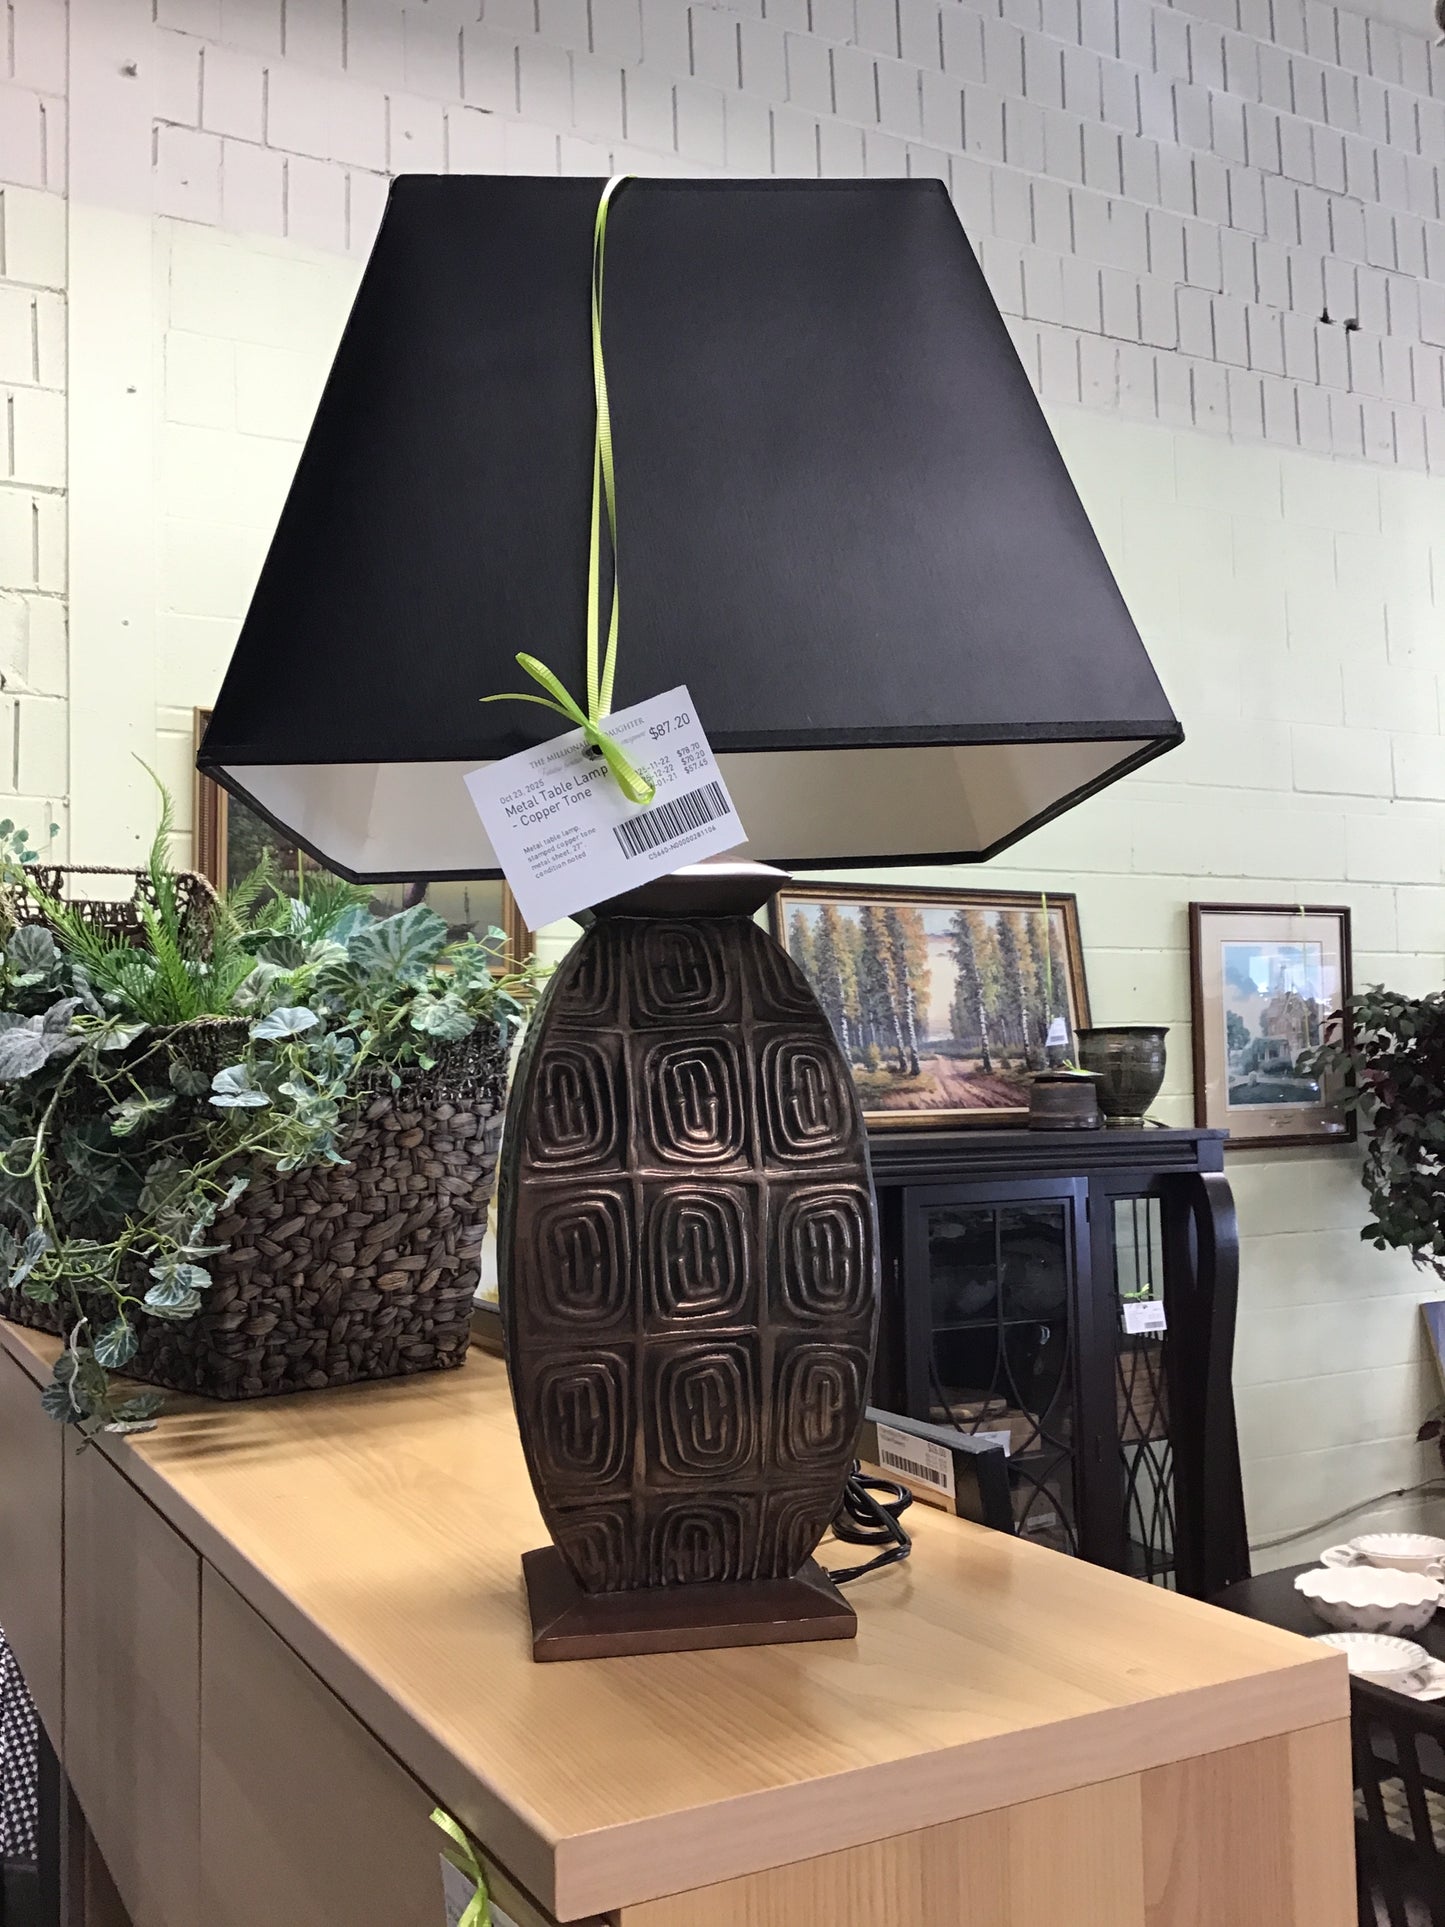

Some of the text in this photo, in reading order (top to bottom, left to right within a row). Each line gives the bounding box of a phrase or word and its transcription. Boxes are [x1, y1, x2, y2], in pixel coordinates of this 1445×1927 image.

[649, 712, 691, 740] $87.20
[677, 742, 701, 758] $78.70
[681, 749, 706, 766] $70.20
[529, 757, 546, 769] THE
[684, 758, 709, 774] $57.45
[500, 794, 514, 805] Oct
[525, 778, 545, 793] 2025
[505, 795, 539, 818] Metal
[539, 782, 573, 802] Table
[573, 765, 609, 787] Lamp
[520, 801, 561, 826] Copper
[562, 788, 592, 806] Tone
[523, 841, 543, 854] Metal
[543, 833, 561, 845] table
[528, 828, 596, 863] stamped copper tone
[531, 859, 551, 871] metal
[535, 851, 587, 879] condition noted
